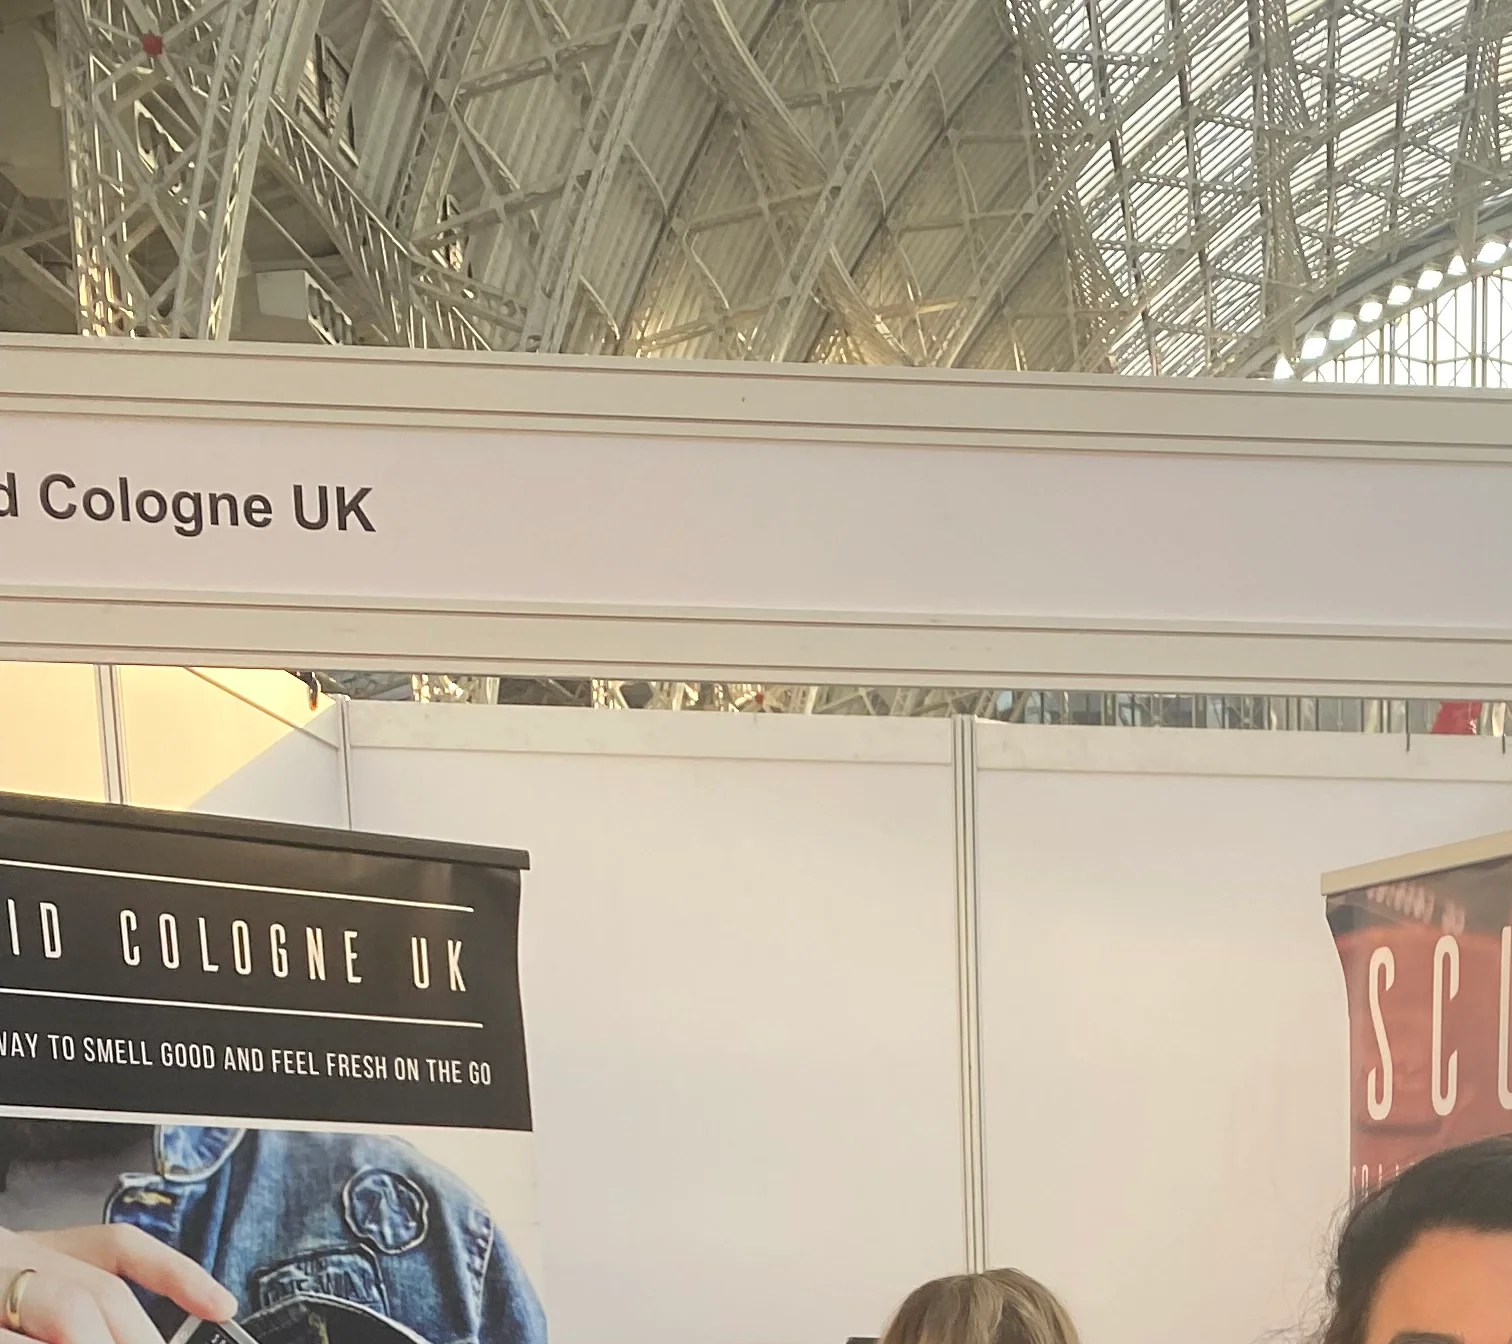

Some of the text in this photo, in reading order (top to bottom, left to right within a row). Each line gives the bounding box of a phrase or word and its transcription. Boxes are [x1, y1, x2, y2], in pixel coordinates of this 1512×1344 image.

[39, 473, 272, 537] Cologne
[293, 484, 376, 533] UK
[119, 908, 362, 984] COLOGNE
[411, 936, 467, 992] UK
[47, 1034, 75, 1062] TO
[83, 1037, 154, 1067] SMELL
[160, 1041, 216, 1070] GOOD
[223, 1046, 264, 1074] AND
[272, 1049, 320, 1076] FEEL
[326, 1052, 388, 1081] FRESH
[394, 1057, 420, 1082] ON
[425, 1058, 463, 1084] THE
[468, 1061, 492, 1086] GO
